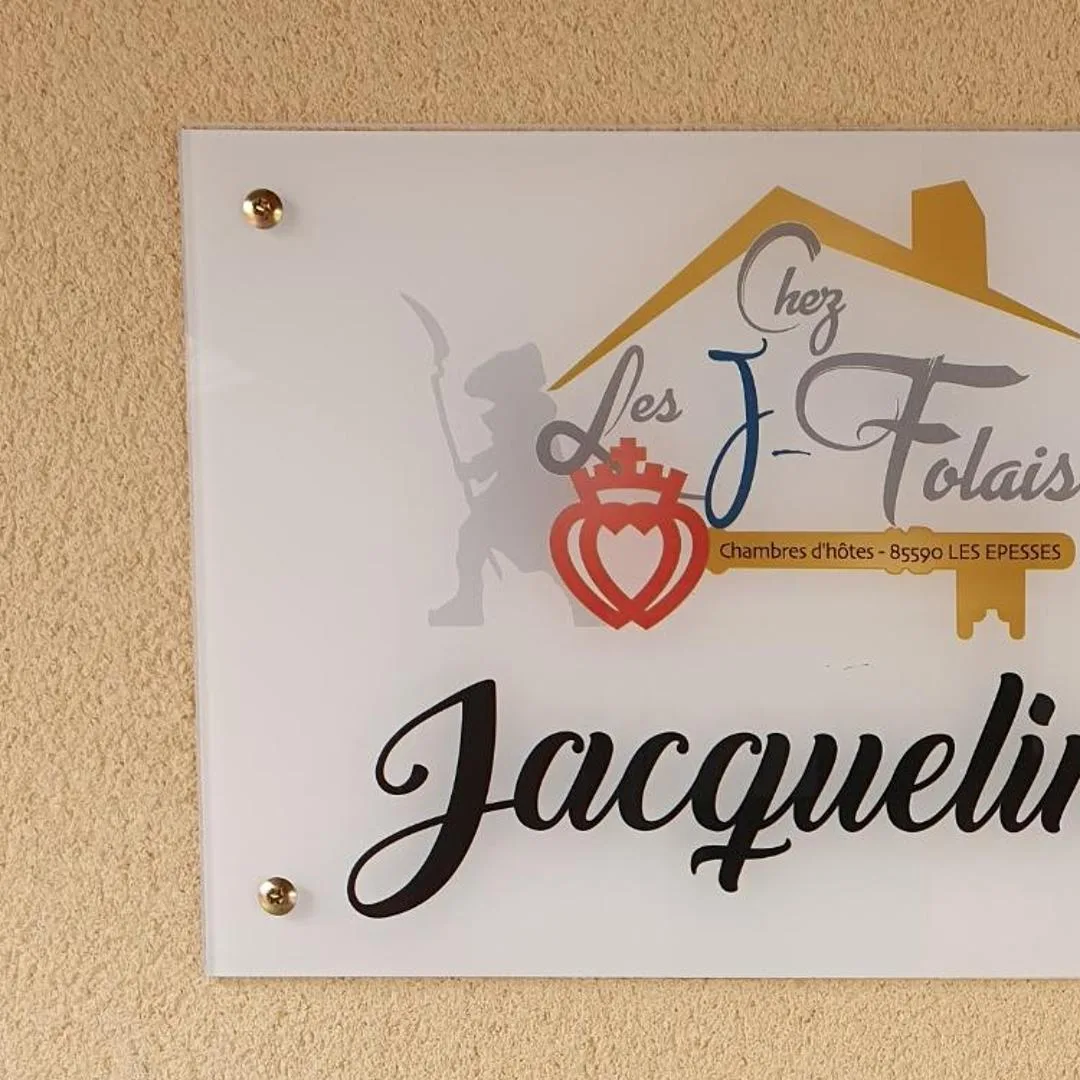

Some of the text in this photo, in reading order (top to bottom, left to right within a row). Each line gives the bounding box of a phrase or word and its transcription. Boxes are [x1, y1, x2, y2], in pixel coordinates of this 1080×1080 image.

[736, 222, 846, 354] Chez
[535, 344, 683, 476] Les
[719, 541, 807, 561] Chambres
[811, 541, 874, 560] d'hôtes
[889, 543, 943, 563] 85590
[949, 543, 980, 560] LES
[985, 543, 1061, 560] EPESSES
